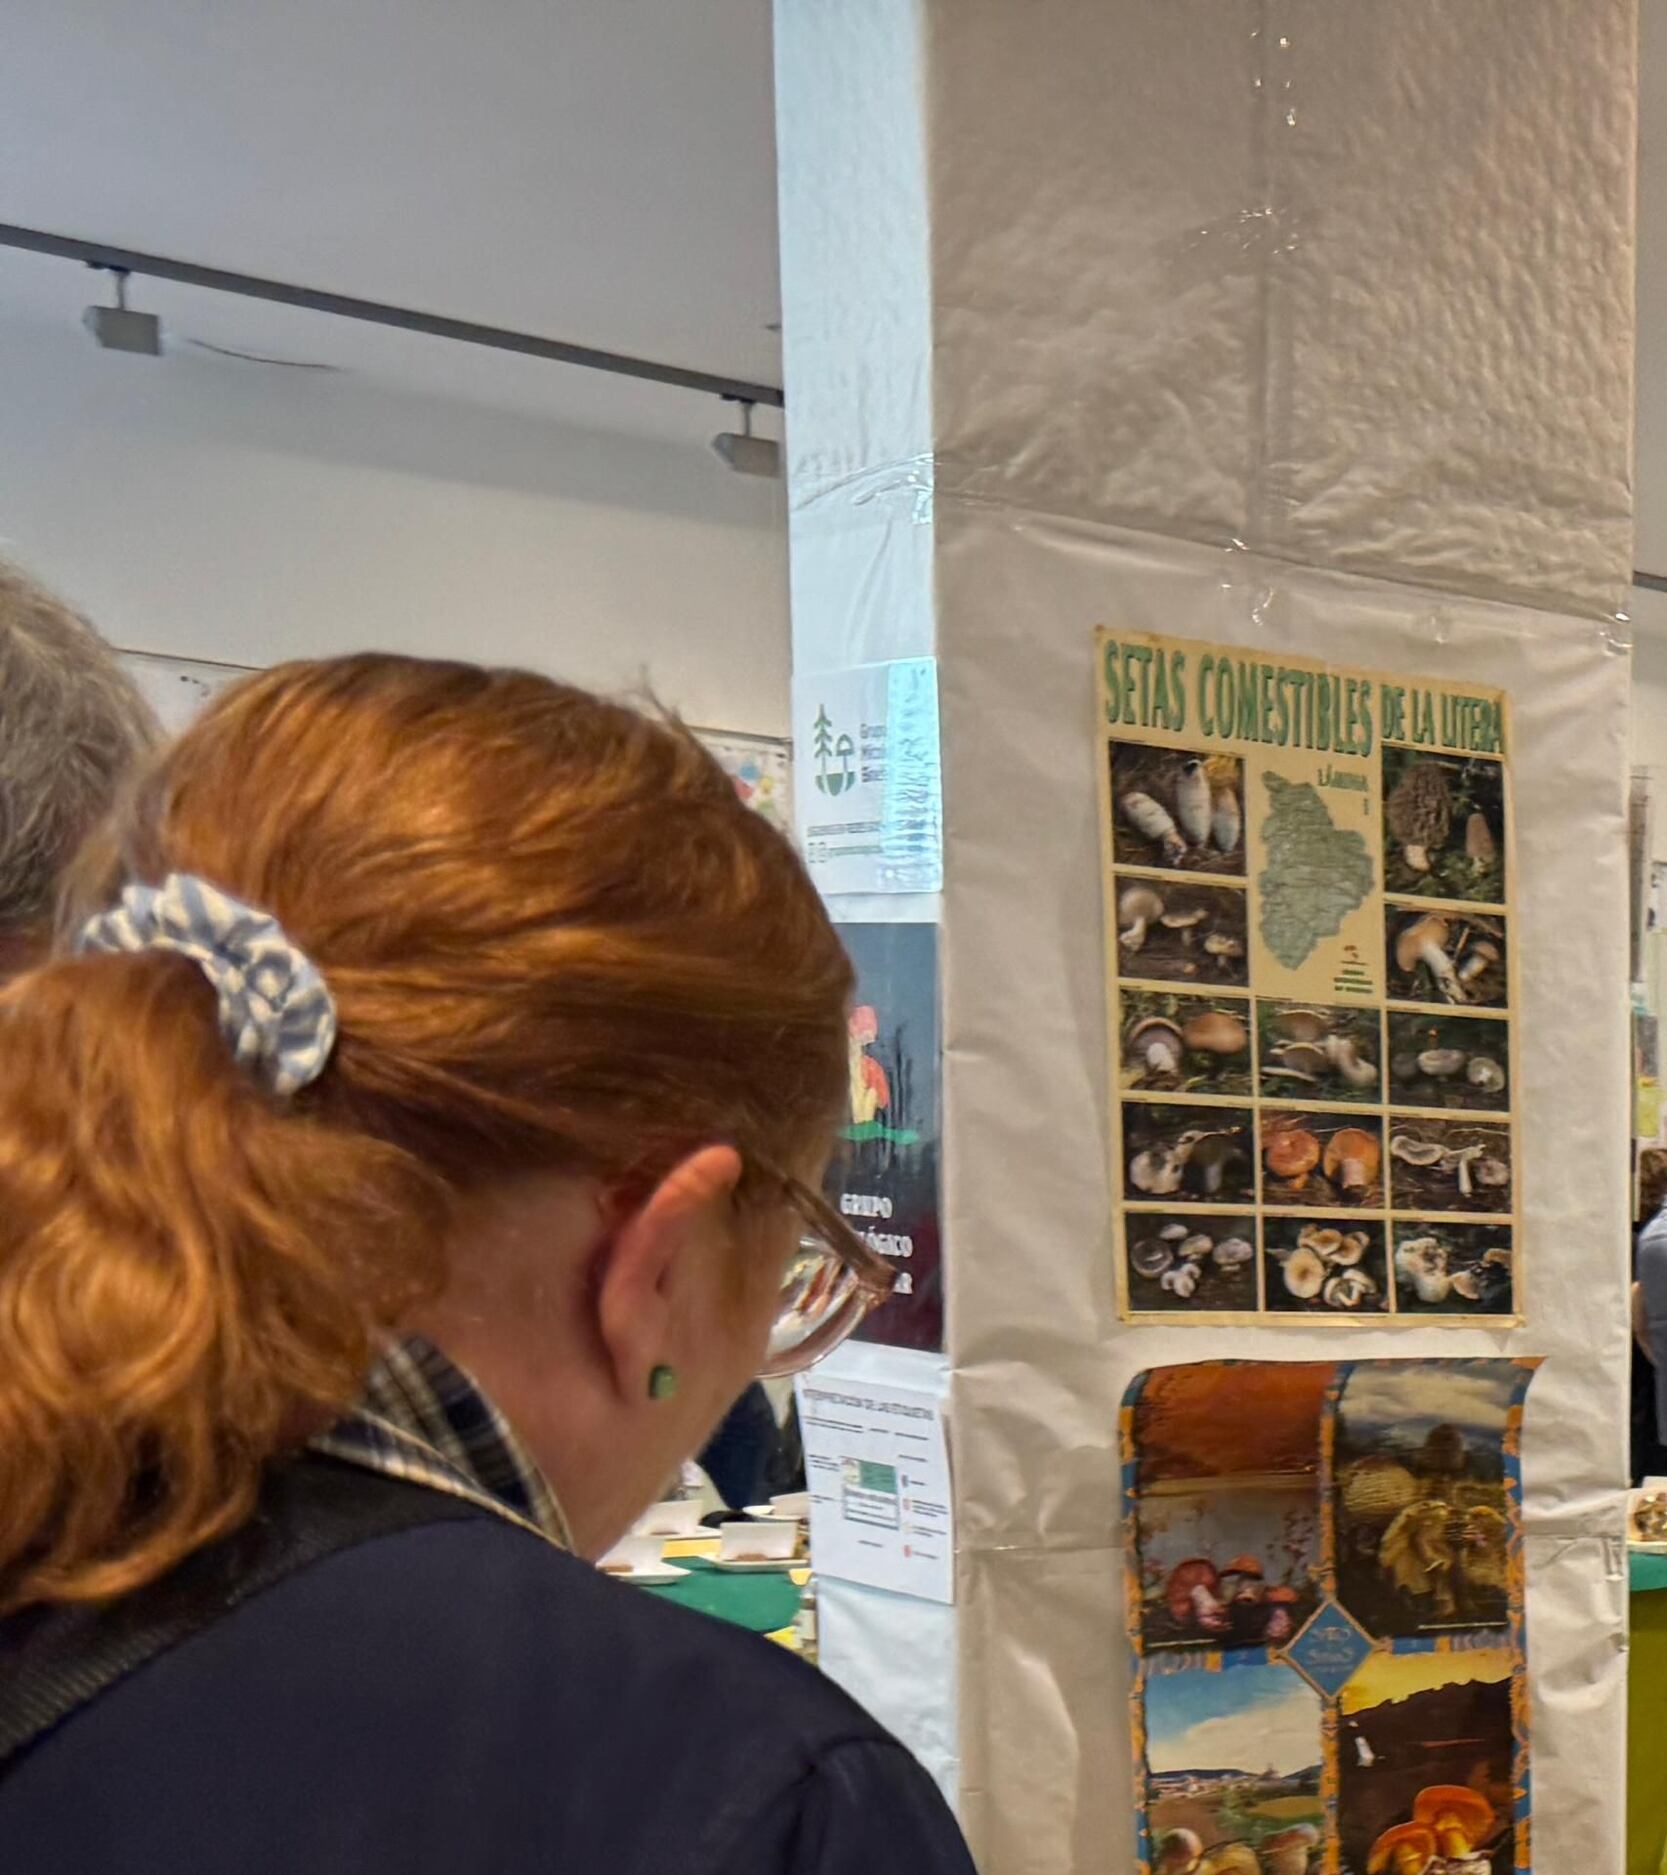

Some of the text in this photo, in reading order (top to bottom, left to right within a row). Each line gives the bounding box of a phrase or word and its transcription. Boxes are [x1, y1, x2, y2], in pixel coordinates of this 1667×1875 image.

[1104, 639, 1187, 732] SETAS
[1198, 653, 1372, 757] COMESTIBLES
[1381, 684, 1406, 740] DE
[1412, 688, 1436, 745] LA
[840, 1193, 893, 1219] GRUPO
[855, 1225, 914, 1258] ÓGICO
